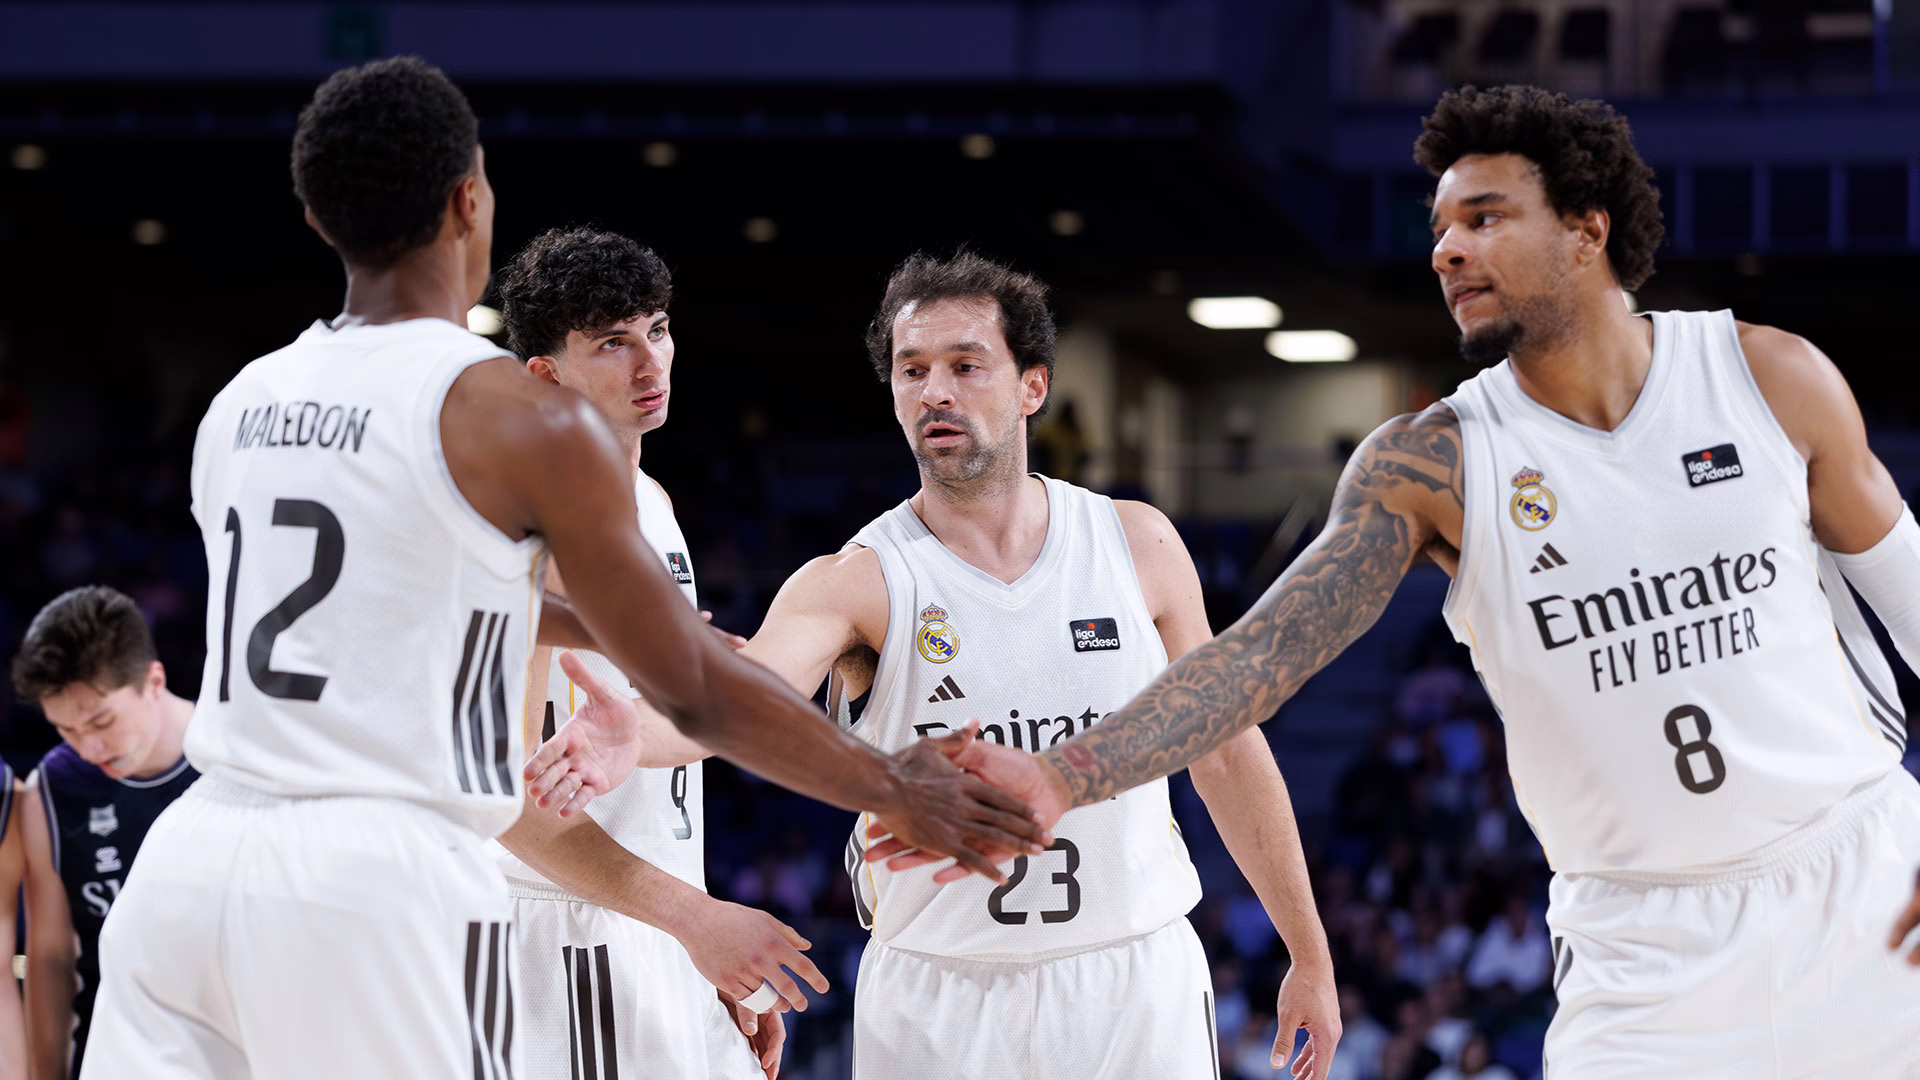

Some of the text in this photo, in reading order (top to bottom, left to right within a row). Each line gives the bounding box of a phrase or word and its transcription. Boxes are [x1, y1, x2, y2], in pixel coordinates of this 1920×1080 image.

[232, 402, 371, 452] MALEDON
[1688, 461, 1713, 473] liga
[1692, 464, 1741, 484] endesa
[219, 498, 344, 702] 12
[1075, 629, 1096, 640] liga
[1526, 548, 1776, 650] Emirates
[1077, 637, 1118, 648] endesa
[1589, 607, 1760, 693] FLY BETTER
[1663, 704, 1727, 794] 8
[671, 765, 693, 841] 9
[987, 838, 1081, 926] 23
